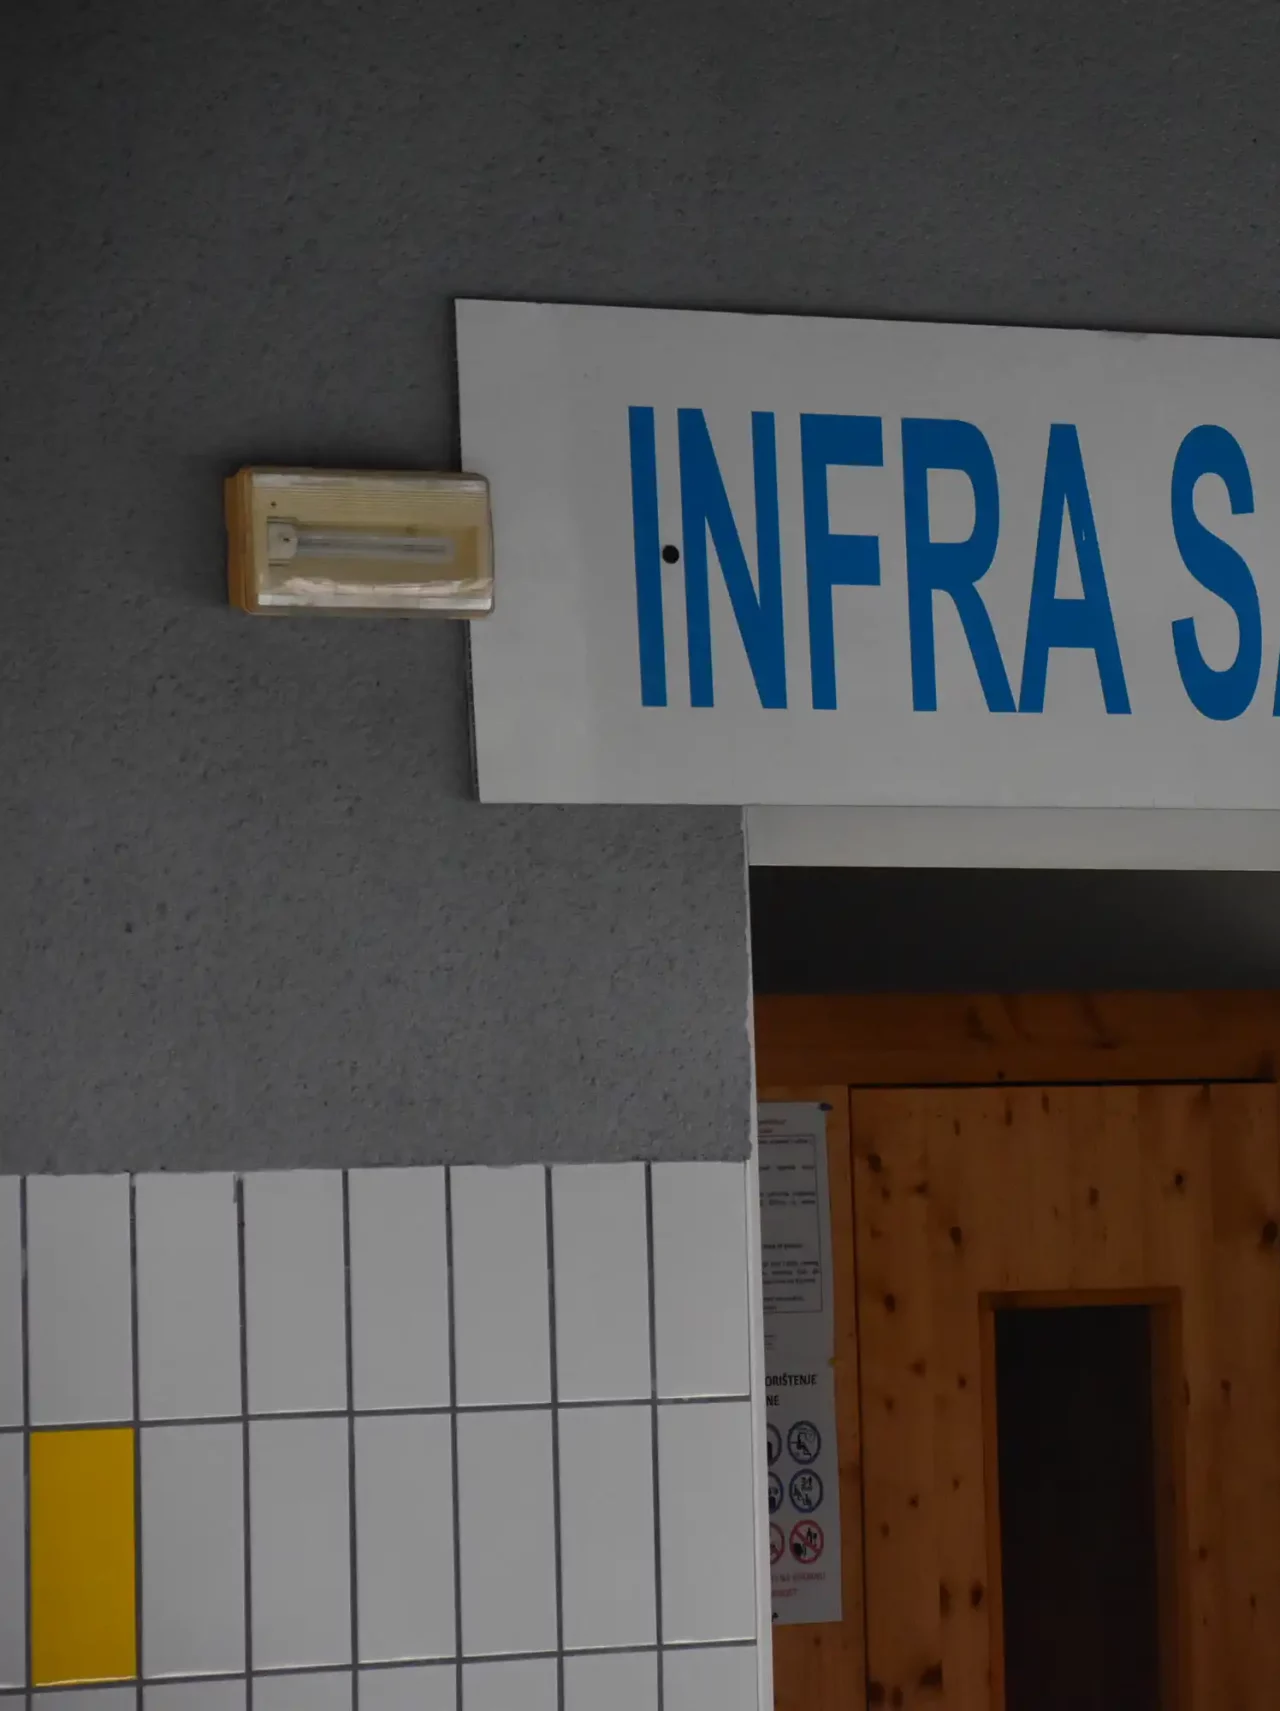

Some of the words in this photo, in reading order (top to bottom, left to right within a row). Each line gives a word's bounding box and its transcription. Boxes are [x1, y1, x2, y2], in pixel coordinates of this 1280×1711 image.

[629, 407, 1131, 714] INFRA
[765, 1373, 818, 1387] ORIŠTENJE
[766, 1395, 780, 1407] NE
